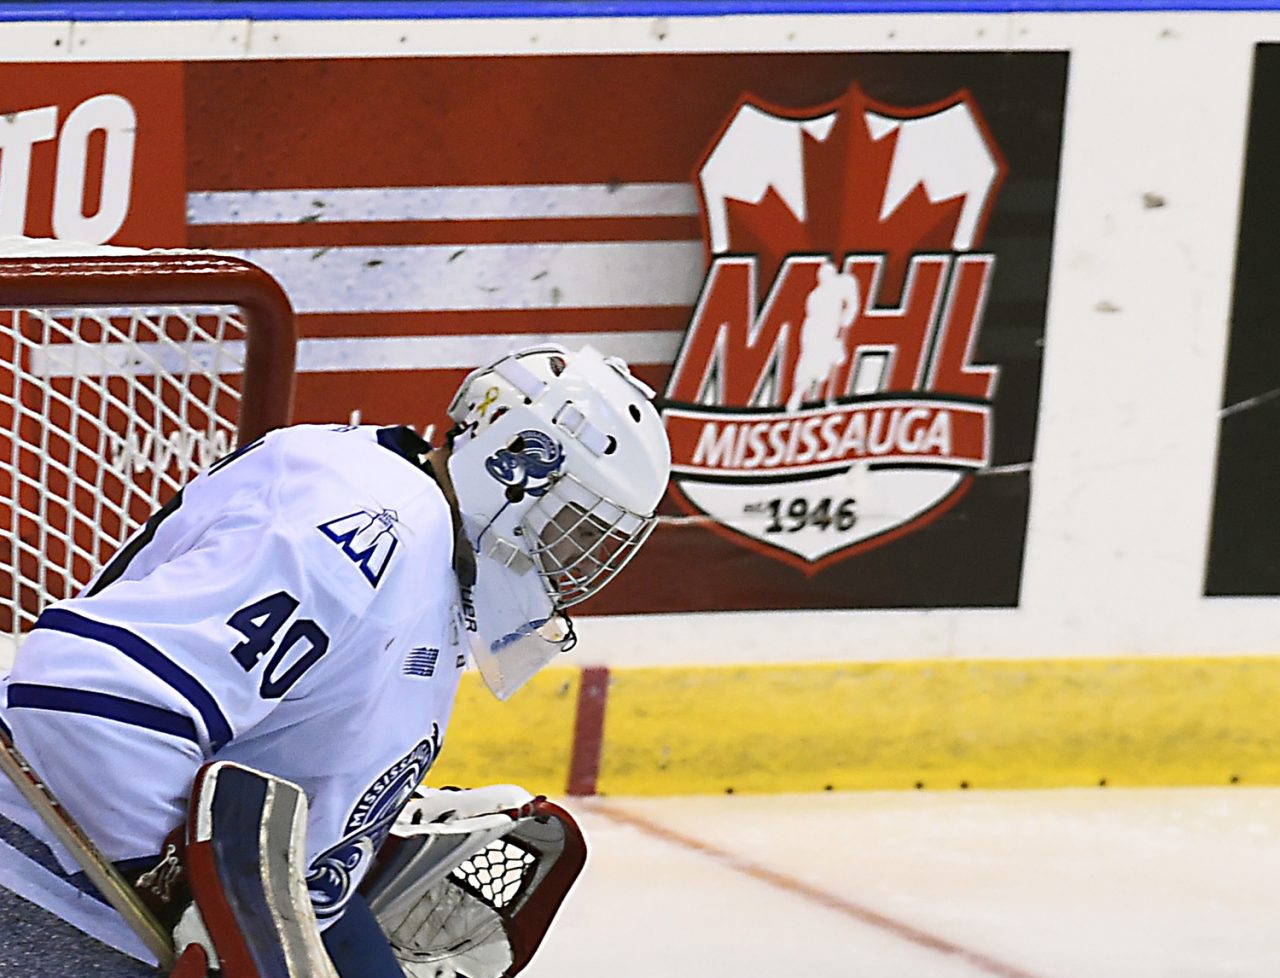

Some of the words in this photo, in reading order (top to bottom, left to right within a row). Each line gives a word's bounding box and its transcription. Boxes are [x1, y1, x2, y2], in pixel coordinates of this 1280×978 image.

[663, 254, 1000, 408] MHL
[692, 408, 951, 469] MISSISSAUGA
[765, 498, 857, 533] 1946
[226, 589, 330, 699] 40
